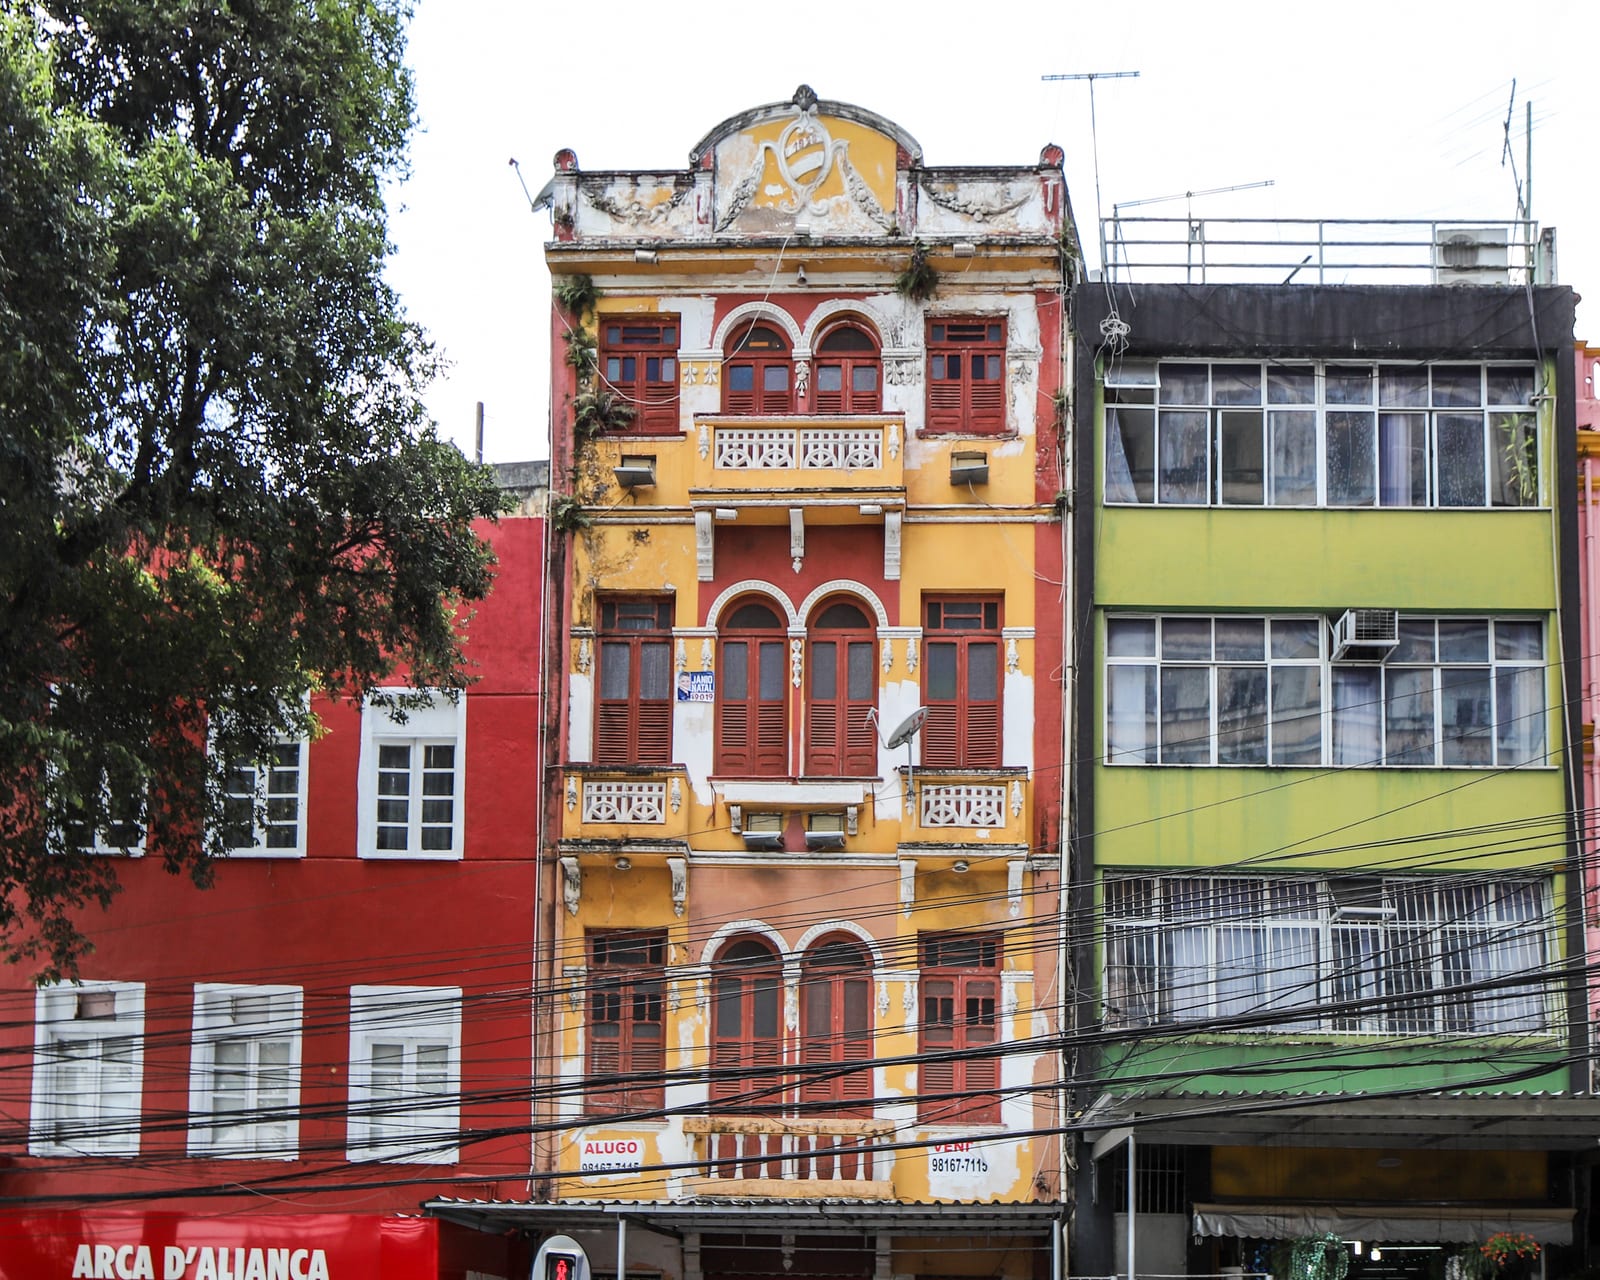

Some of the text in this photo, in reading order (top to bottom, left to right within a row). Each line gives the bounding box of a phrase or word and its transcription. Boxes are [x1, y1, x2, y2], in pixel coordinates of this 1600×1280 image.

[691, 684, 713, 692] NATAL
[584, 1142, 638, 1154] ALUGO
[932, 1158, 988, 1172] 98167-7115
[72, 1243, 155, 1280] ARCA
